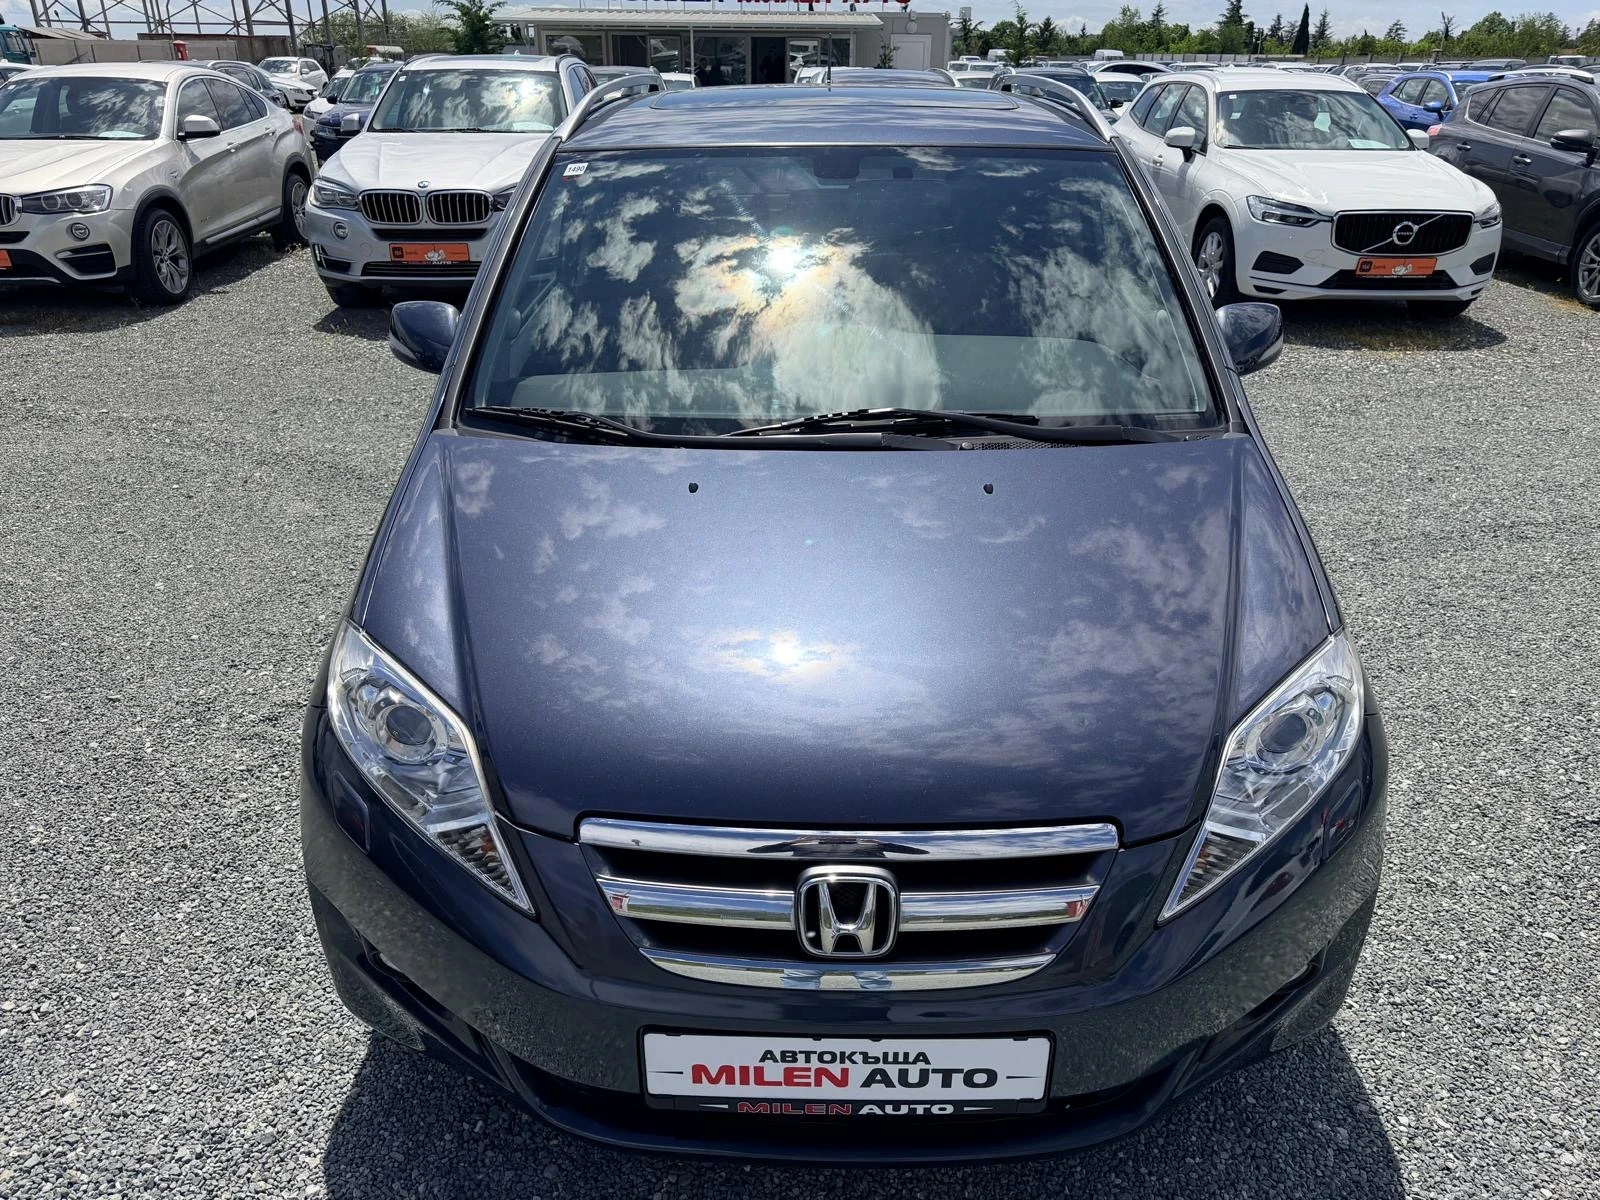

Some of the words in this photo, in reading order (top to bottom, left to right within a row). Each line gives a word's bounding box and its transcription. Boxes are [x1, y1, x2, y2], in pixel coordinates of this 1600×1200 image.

[691, 1064, 849, 1088] MILEN
[859, 1068, 998, 1089] AUTO
[736, 1102, 852, 1115] MILEN
[857, 1104, 955, 1115] AUTO
